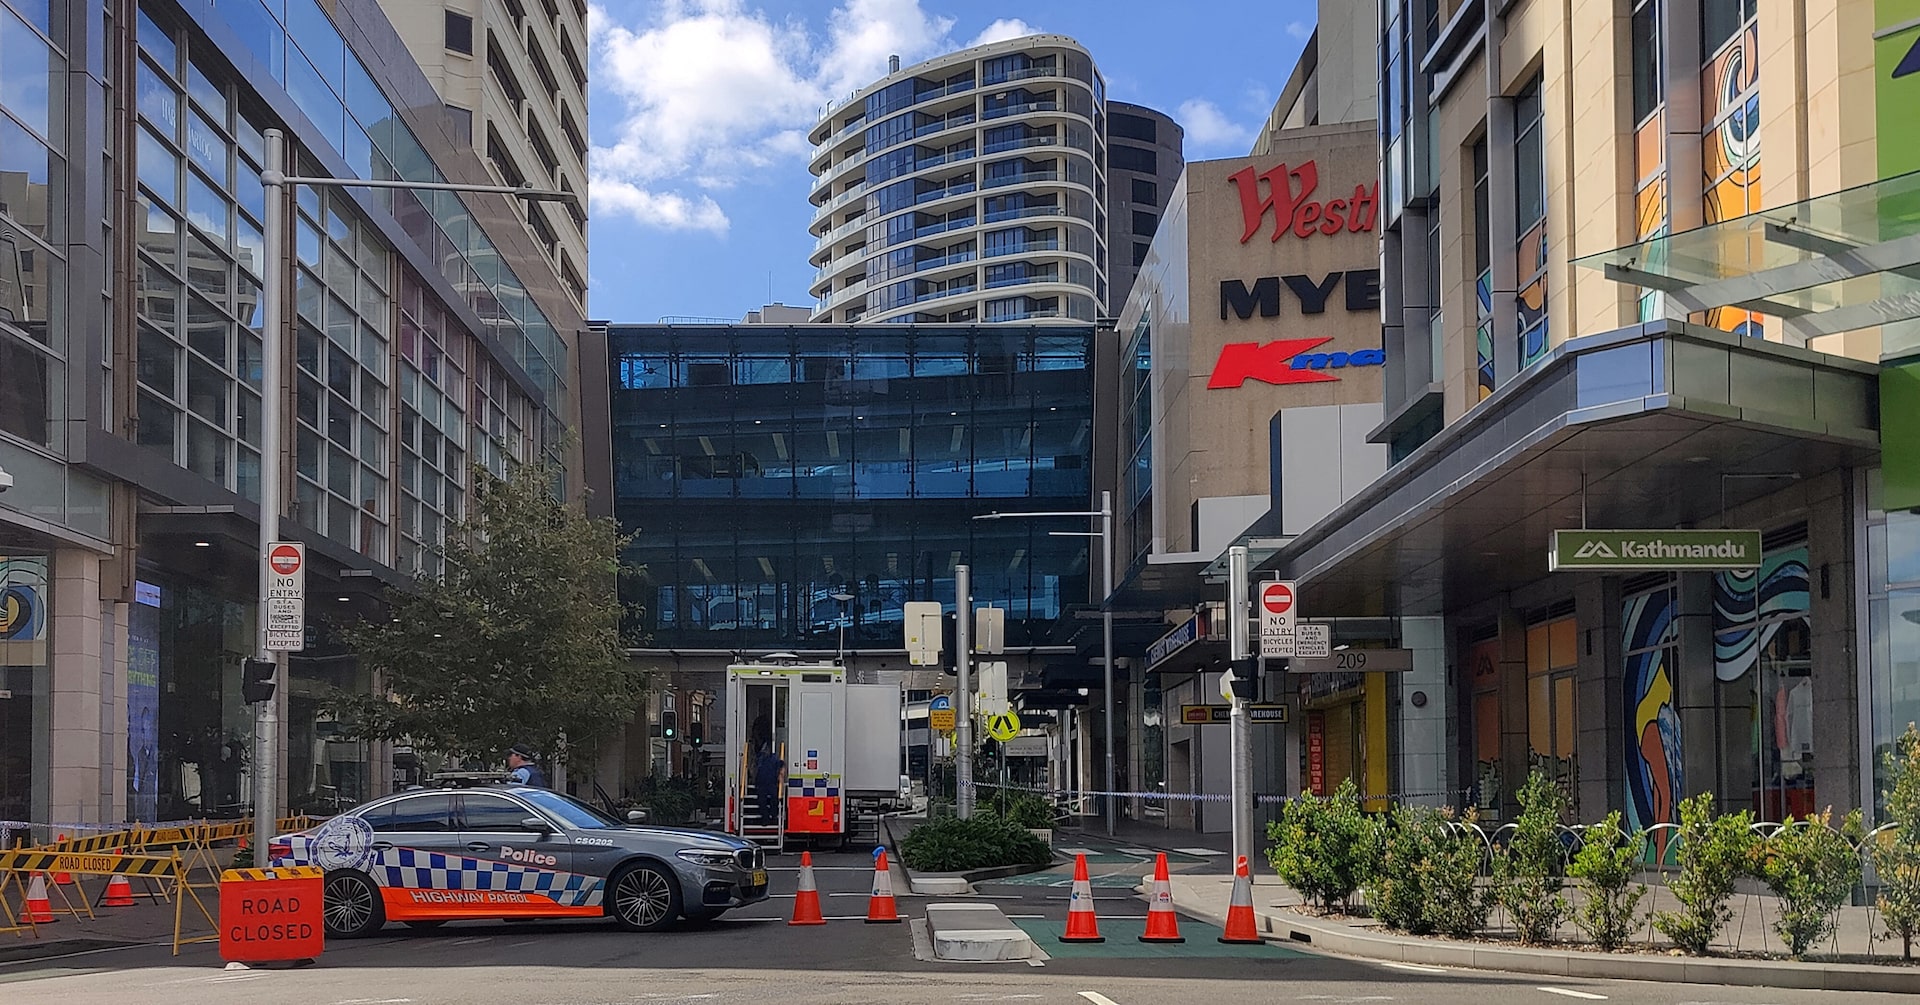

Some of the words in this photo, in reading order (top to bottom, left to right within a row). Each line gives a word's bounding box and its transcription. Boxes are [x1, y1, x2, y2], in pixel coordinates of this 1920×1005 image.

[1220, 268, 1380, 320] MYE
[1621, 540, 1745, 558] Kathmandu
[276, 578, 294, 587] NO
[270, 590, 300, 598] ENTRY
[1270, 616, 1286, 625] NO
[1336, 652, 1366, 669] 209
[60, 856, 80, 870] ROAD
[84, 858, 111, 871] CLOSED
[500, 846, 557, 866] Police
[410, 890, 484, 903] HIGHWAY
[488, 893, 530, 904] PATROL
[242, 898, 300, 915] ROAD
[230, 924, 312, 942] CLOSED
